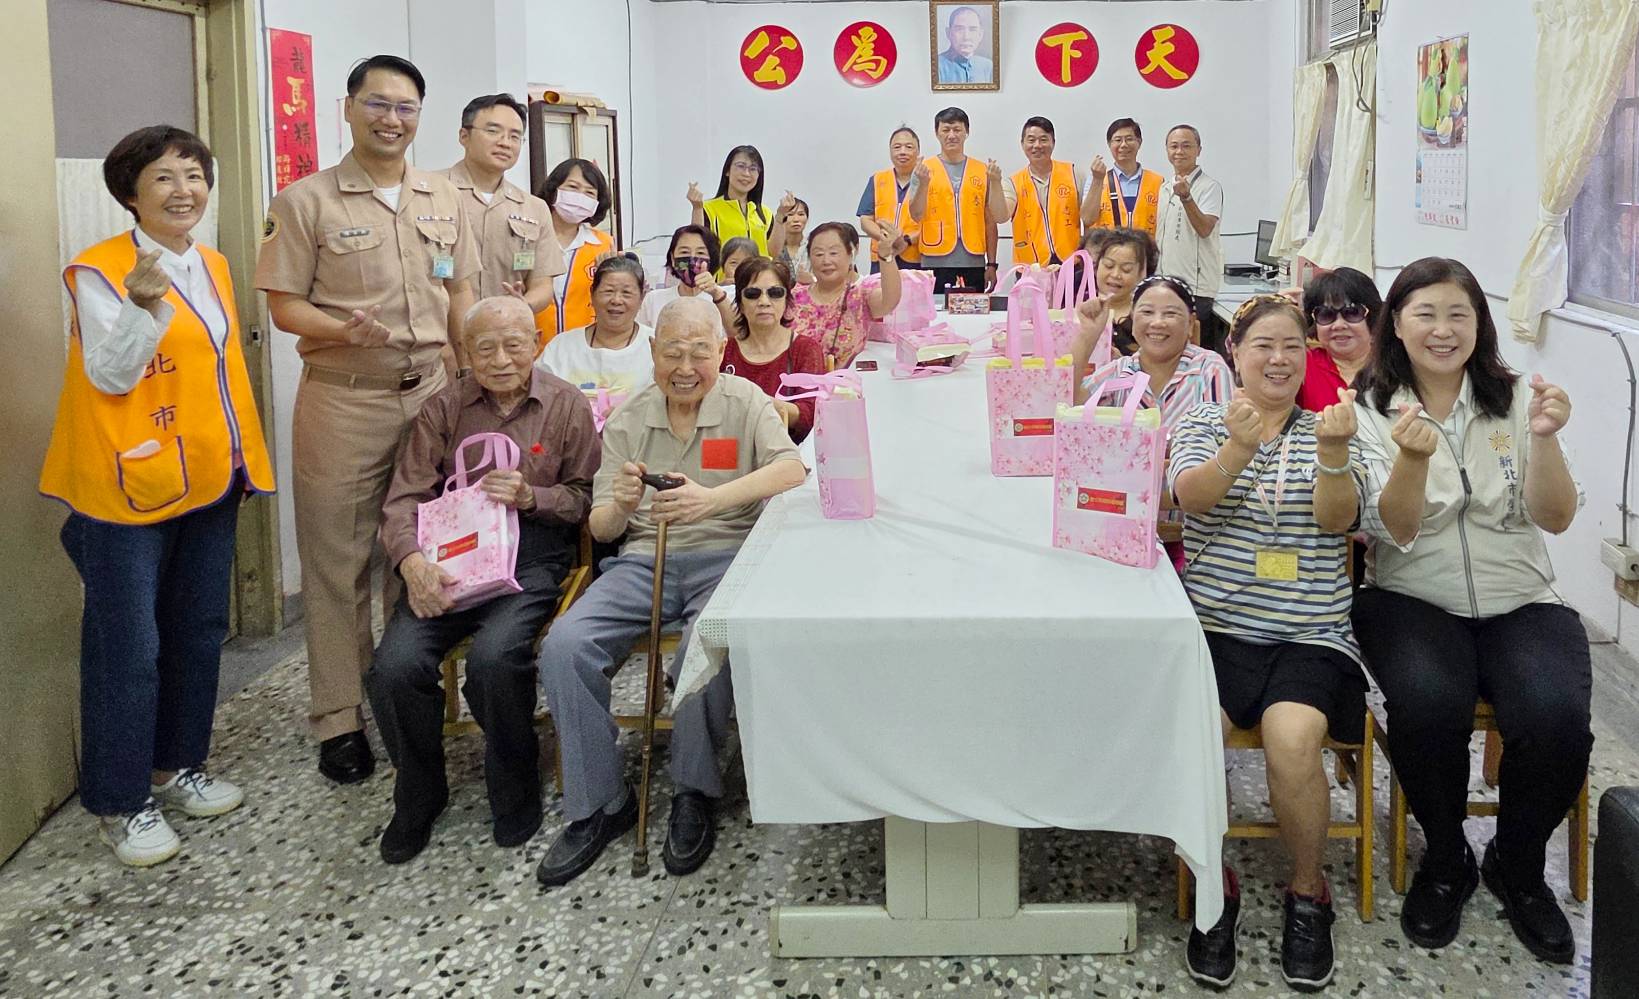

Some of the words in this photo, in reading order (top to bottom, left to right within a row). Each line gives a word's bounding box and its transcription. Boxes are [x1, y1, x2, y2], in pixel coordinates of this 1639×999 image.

[743, 30, 798, 85] 公
[842, 26, 888, 81] 為
[1042, 30, 1088, 83] 下
[1140, 25, 1189, 81] 天
